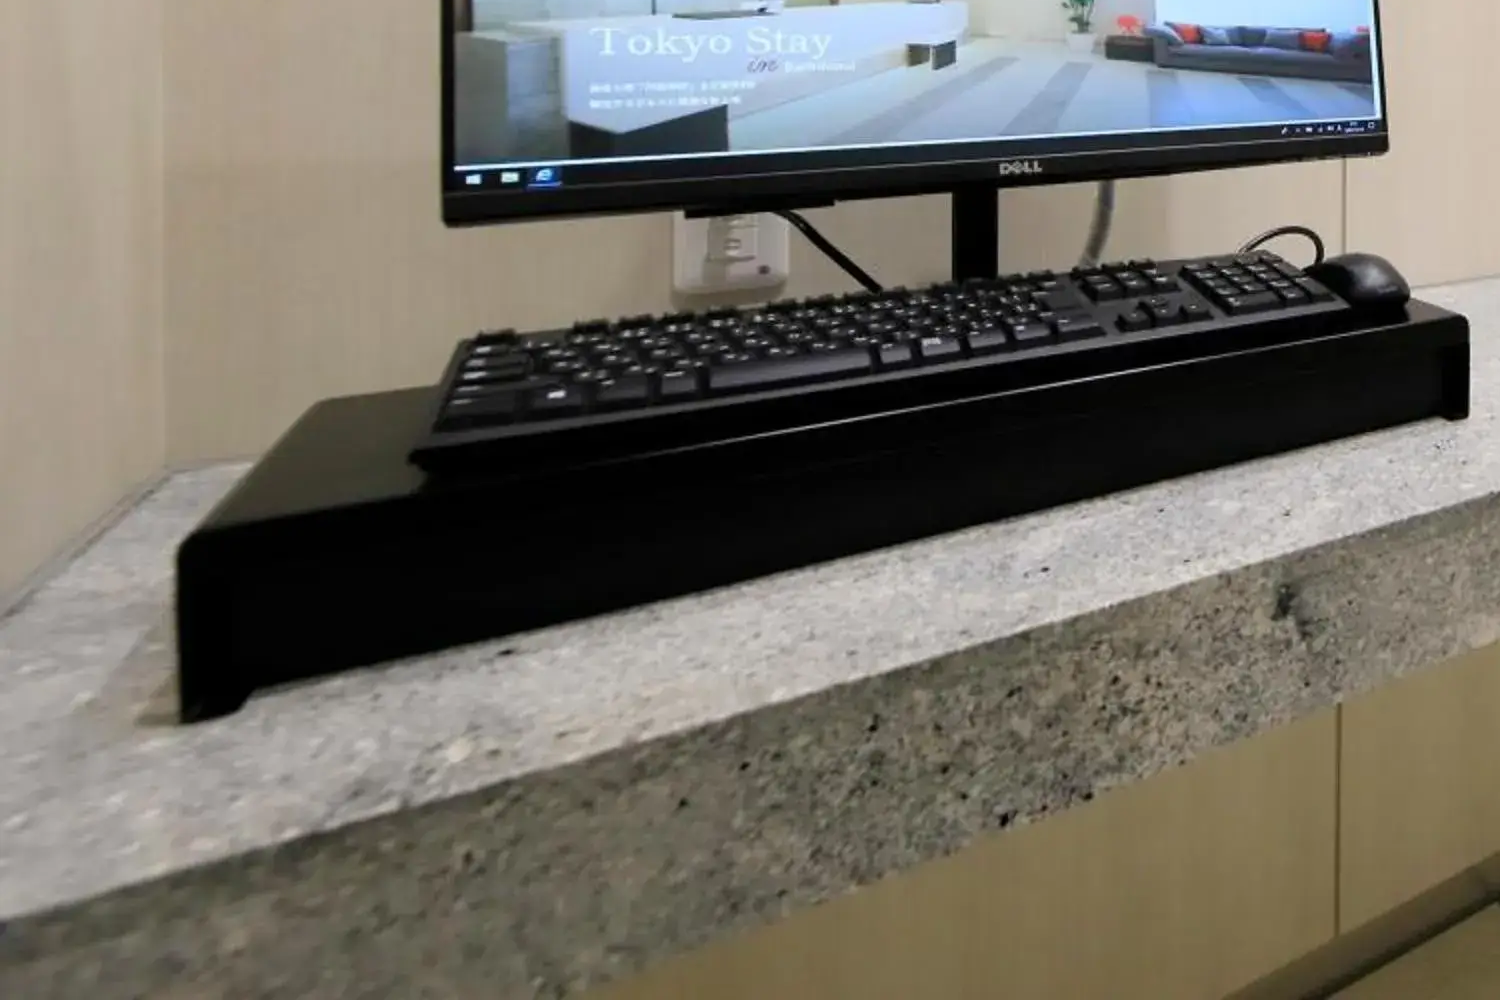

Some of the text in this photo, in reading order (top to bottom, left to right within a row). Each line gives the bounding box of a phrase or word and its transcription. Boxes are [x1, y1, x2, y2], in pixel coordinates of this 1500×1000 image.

[589, 25, 832, 63] Tokyo Stay
[999, 160, 1043, 175] DELL
